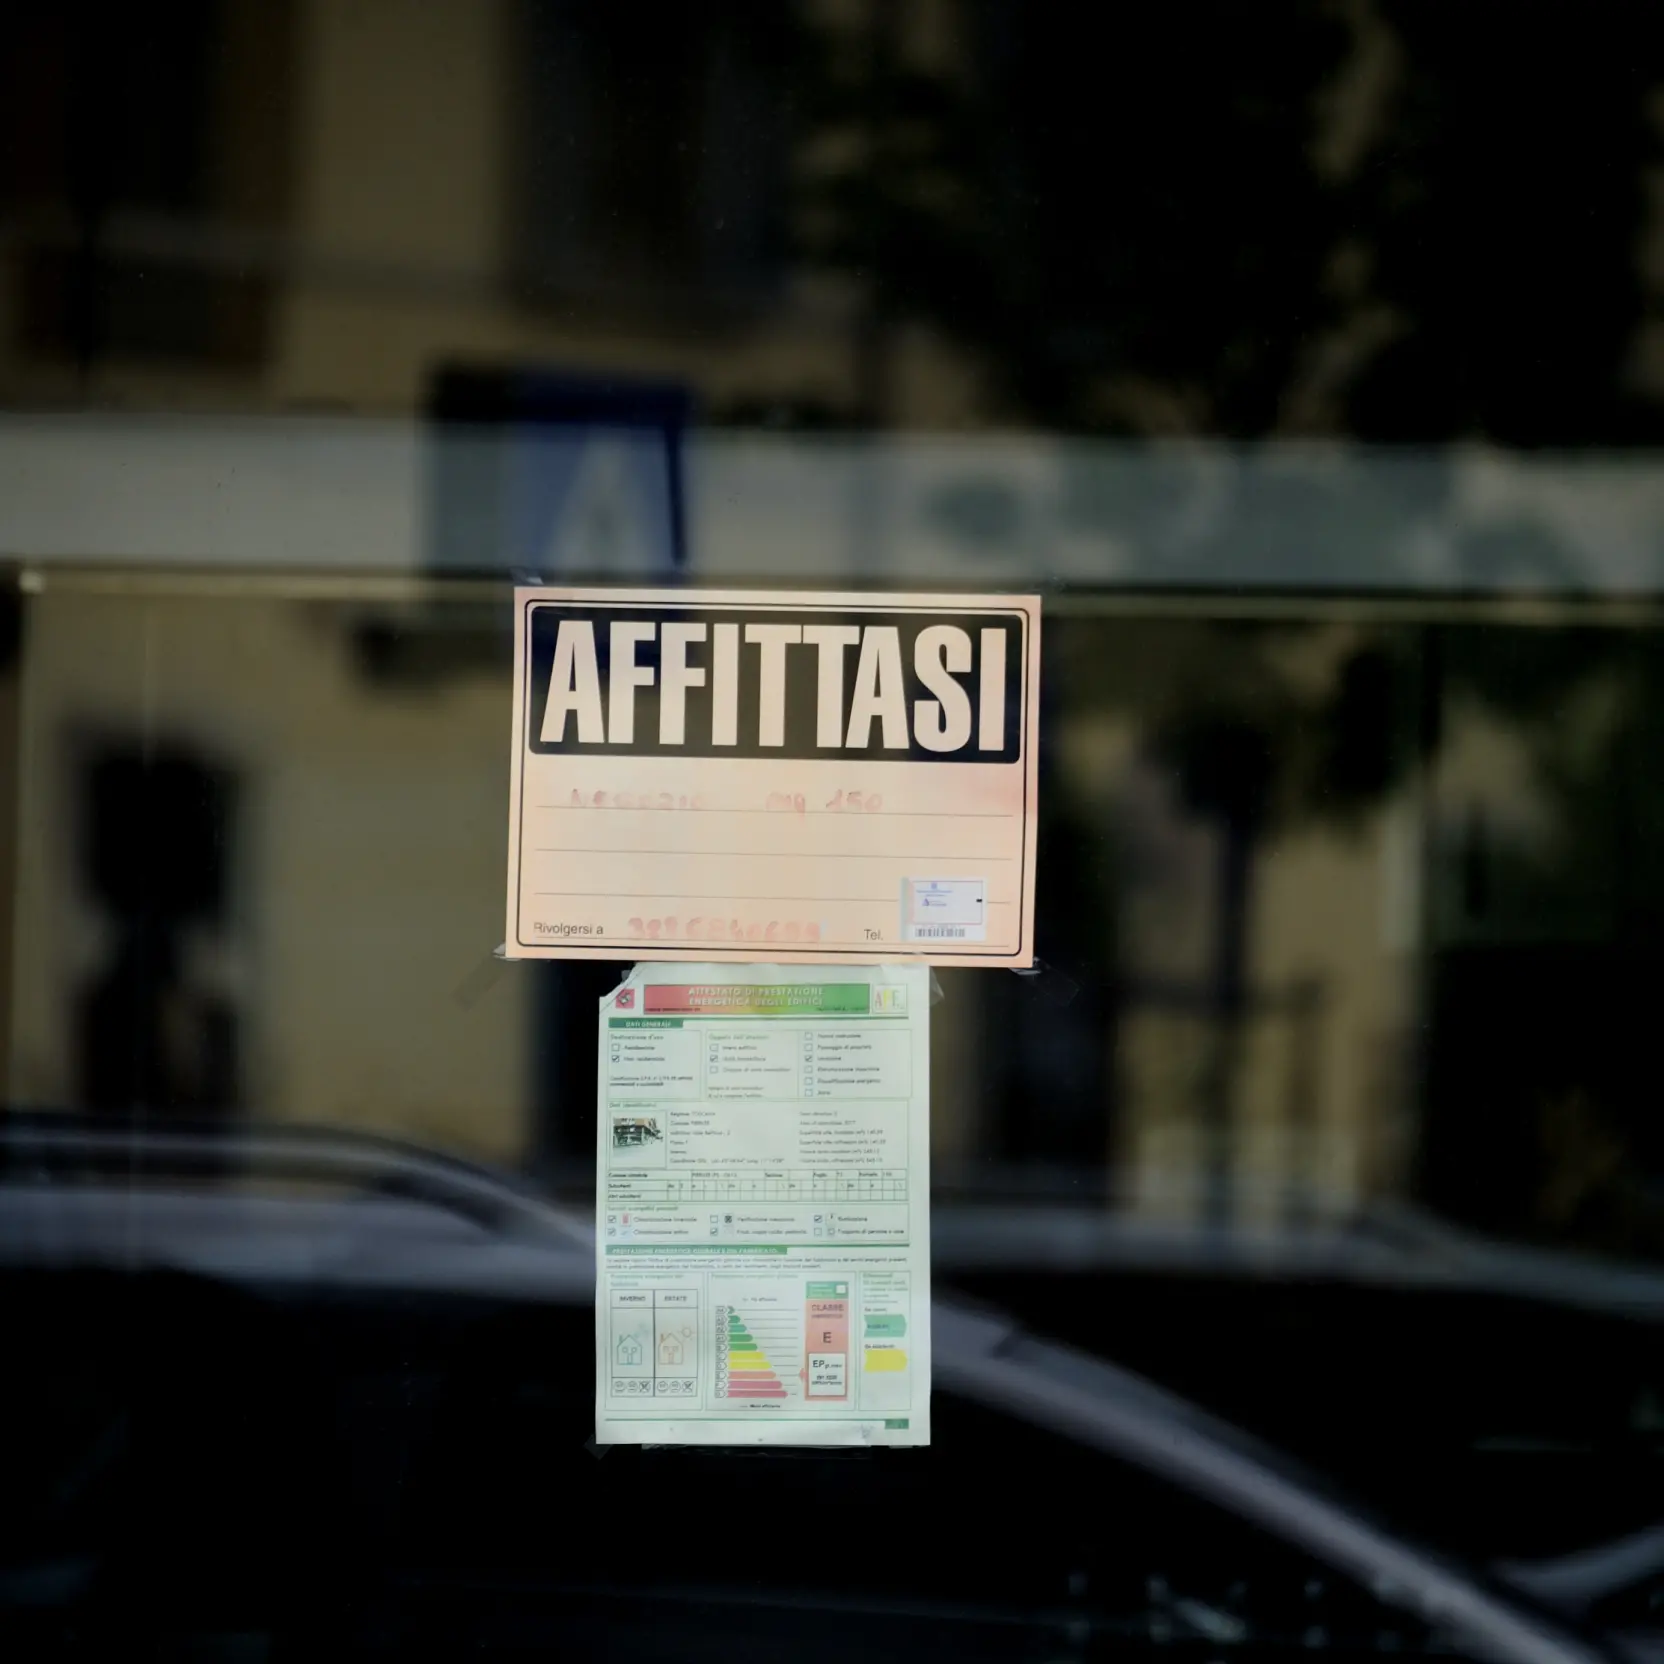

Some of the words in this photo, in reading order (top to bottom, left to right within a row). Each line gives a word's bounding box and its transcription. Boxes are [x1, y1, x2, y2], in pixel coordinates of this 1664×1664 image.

[540, 620, 1007, 752] AFFITTASI
[533, 921, 593, 937] Rivolgersi
[596, 924, 604, 935] a
[863, 929, 884, 941] Tel.
[811, 1303, 844, 1312] CLASSE
[822, 1331, 832, 1344] E
[812, 1359, 825, 1368] EP
